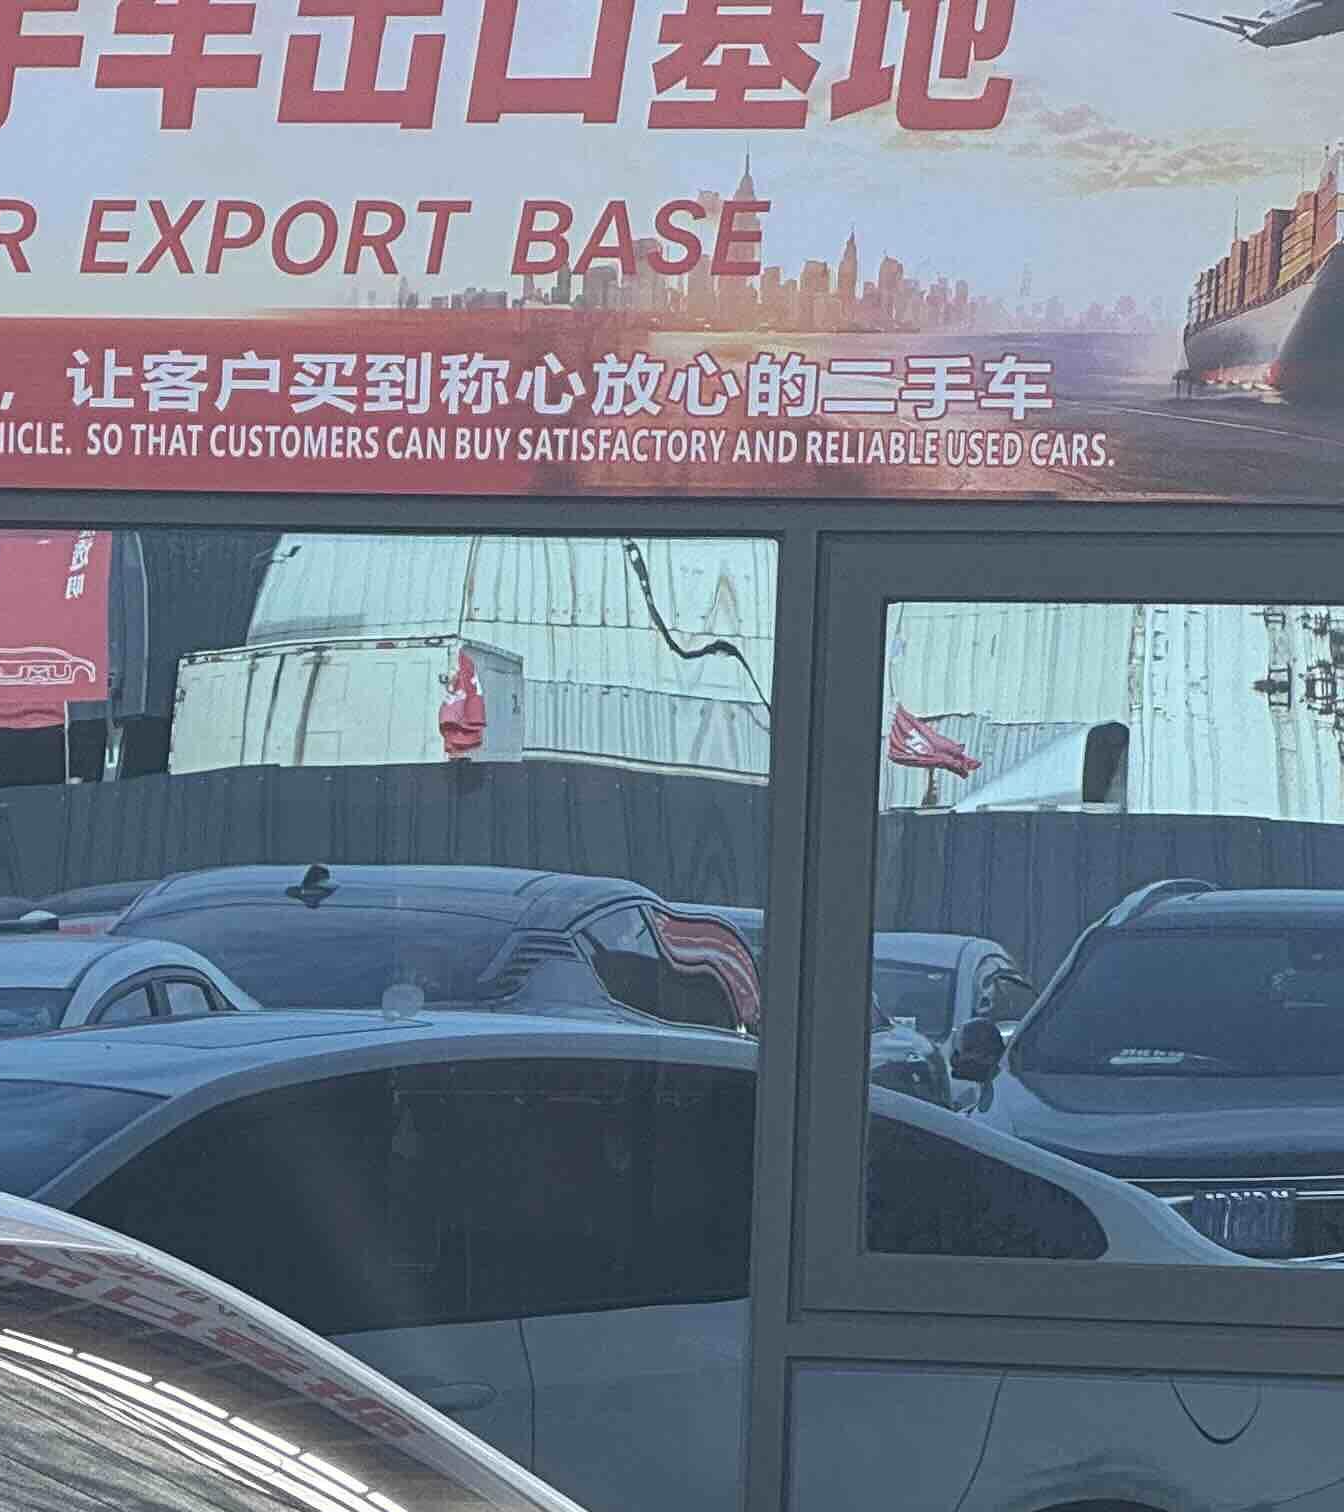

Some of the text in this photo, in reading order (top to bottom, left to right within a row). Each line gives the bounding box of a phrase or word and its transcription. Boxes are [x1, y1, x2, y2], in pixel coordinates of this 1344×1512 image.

[80, 199, 472, 275] EXPORT
[510, 199, 772, 277] BASE
[86, 423, 123, 457] SO
[130, 424, 204, 458] THAT
[210, 425, 379, 460] CUSTOMERS
[386, 427, 446, 461] CAN
[455, 428, 511, 462] BUY
[517, 428, 726, 465] SATISFACTORY
[732, 430, 798, 464] AND
[805, 430, 940, 465] RELIABLE
[945, 431, 1024, 466] USED
[1029, 432, 1116, 468] CARS.
